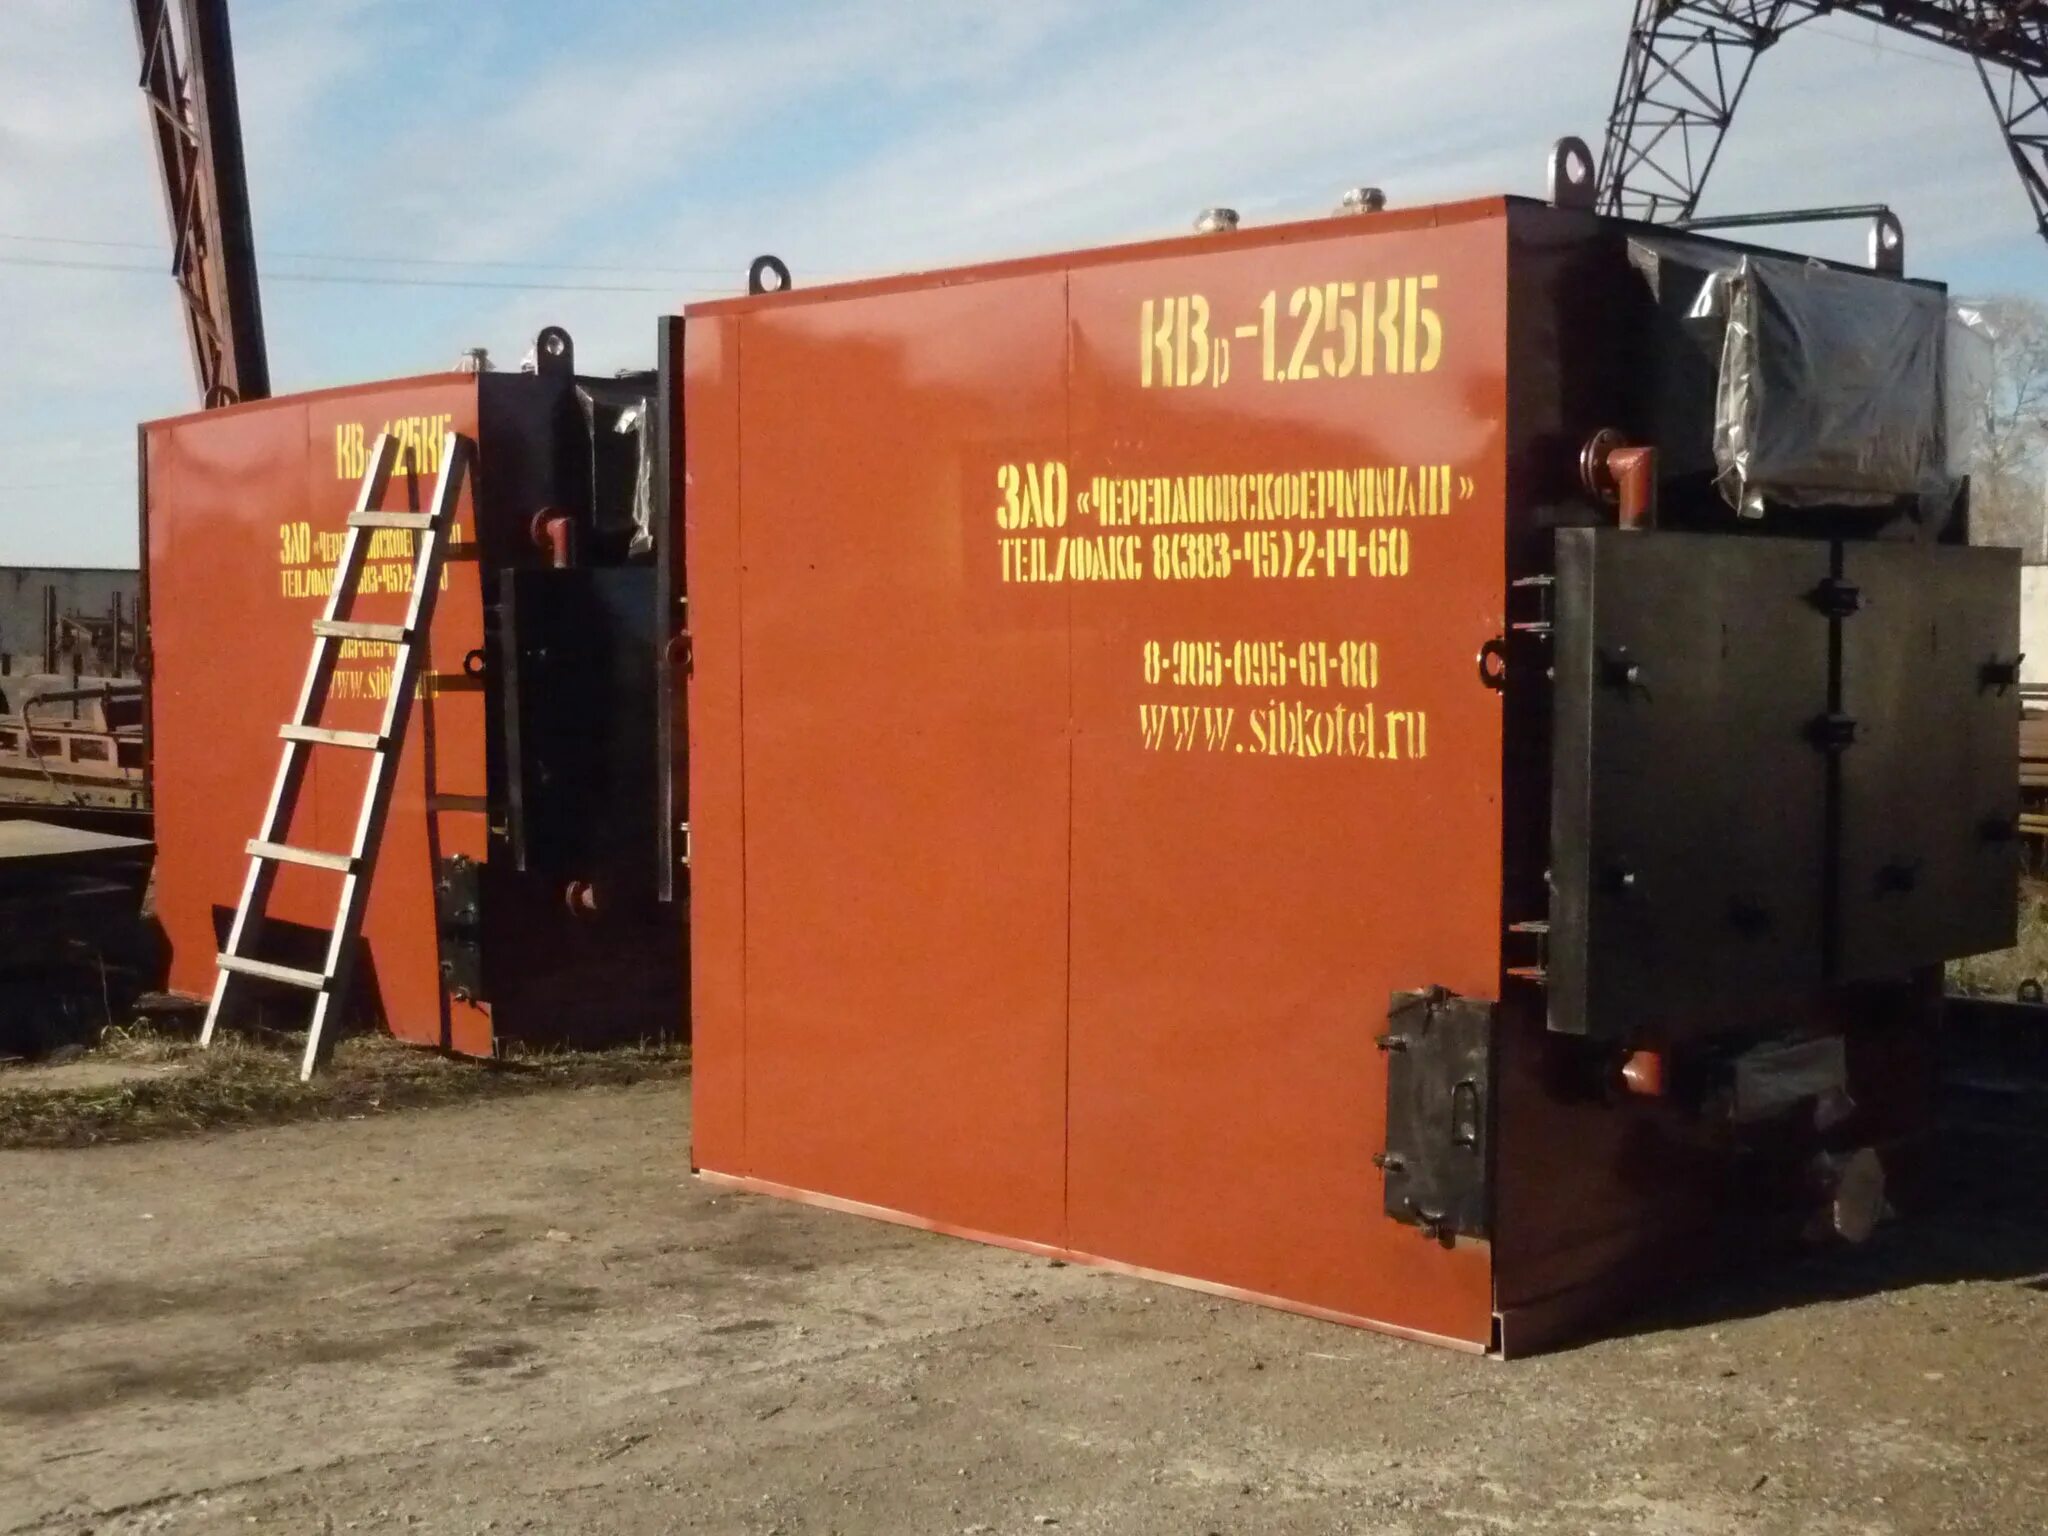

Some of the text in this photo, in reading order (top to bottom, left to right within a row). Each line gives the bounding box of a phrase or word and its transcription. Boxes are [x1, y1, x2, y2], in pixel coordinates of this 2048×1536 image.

[997, 462, 1067, 529] ЗАО
[279, 521, 310, 565] ЗАО
[998, 535, 1142, 583] ТЕЛ./ФАКС
[280, 567, 338, 599] ТЕЛ./ФАК
[1144, 640, 1378, 688] 8-905-095-61-80
[1139, 699, 1427, 760] www.sibkotel.ru
